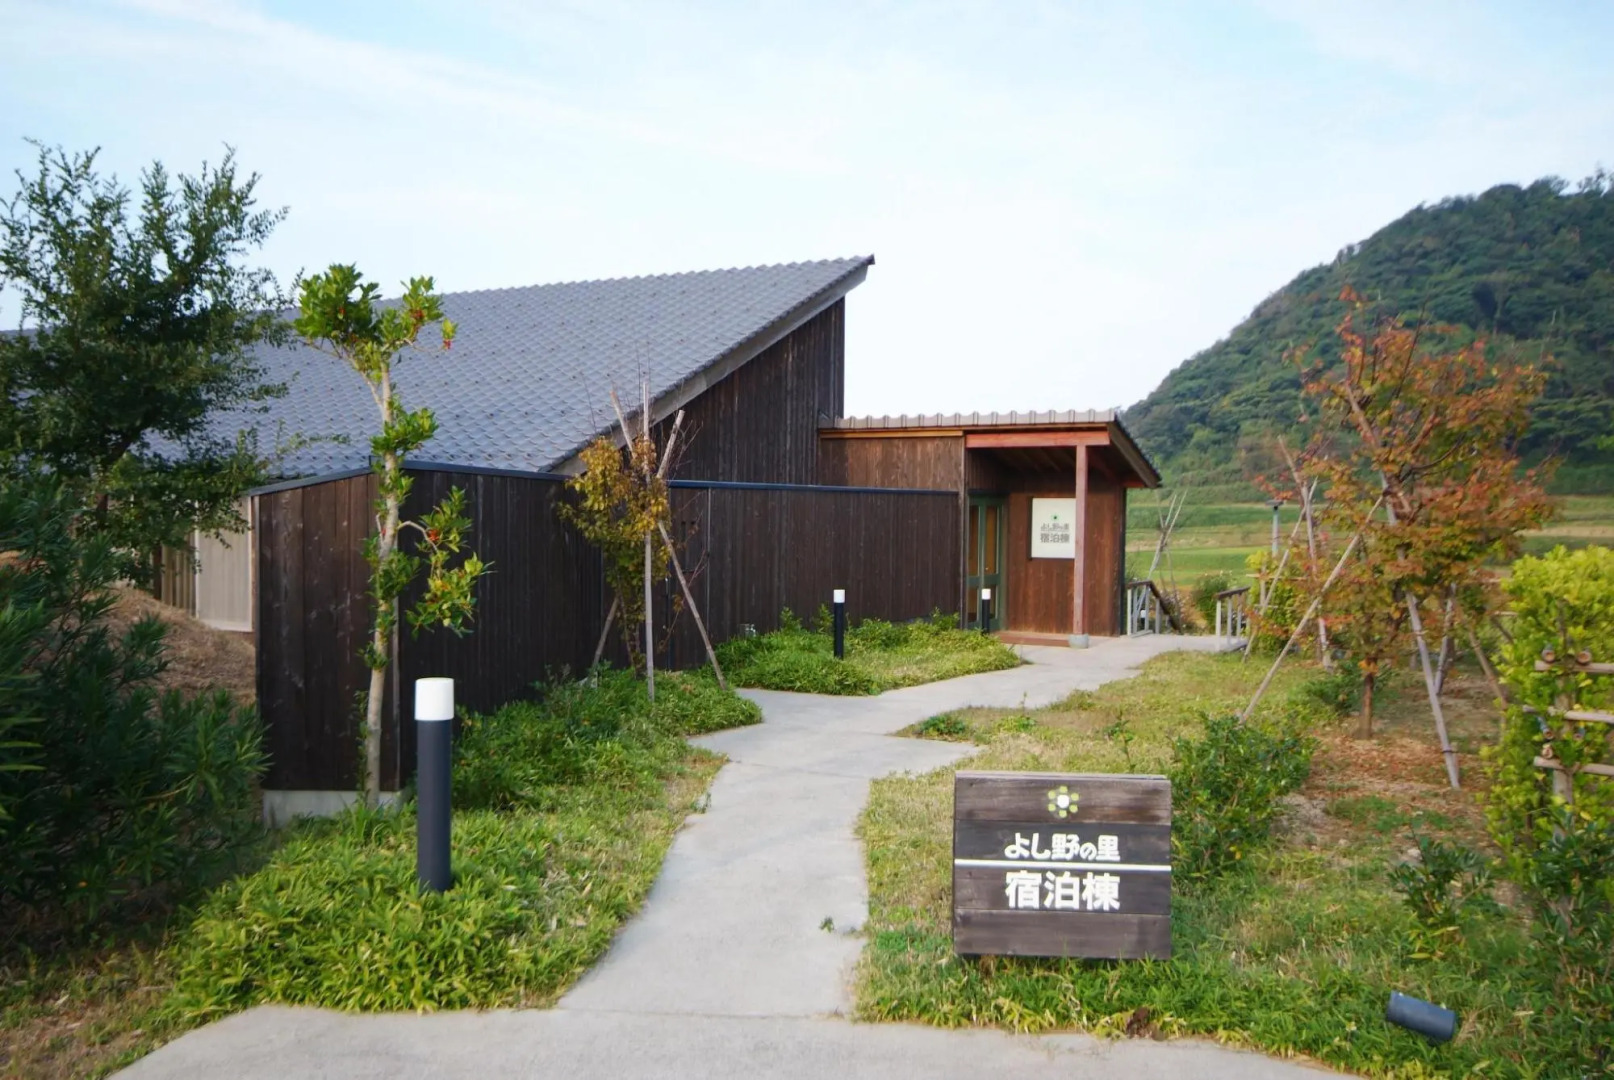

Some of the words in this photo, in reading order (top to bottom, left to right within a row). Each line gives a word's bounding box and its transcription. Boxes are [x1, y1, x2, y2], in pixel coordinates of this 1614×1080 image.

[1004, 832, 1121, 861] よし野の里
[1005, 870, 1121, 911] 宿泊棟
